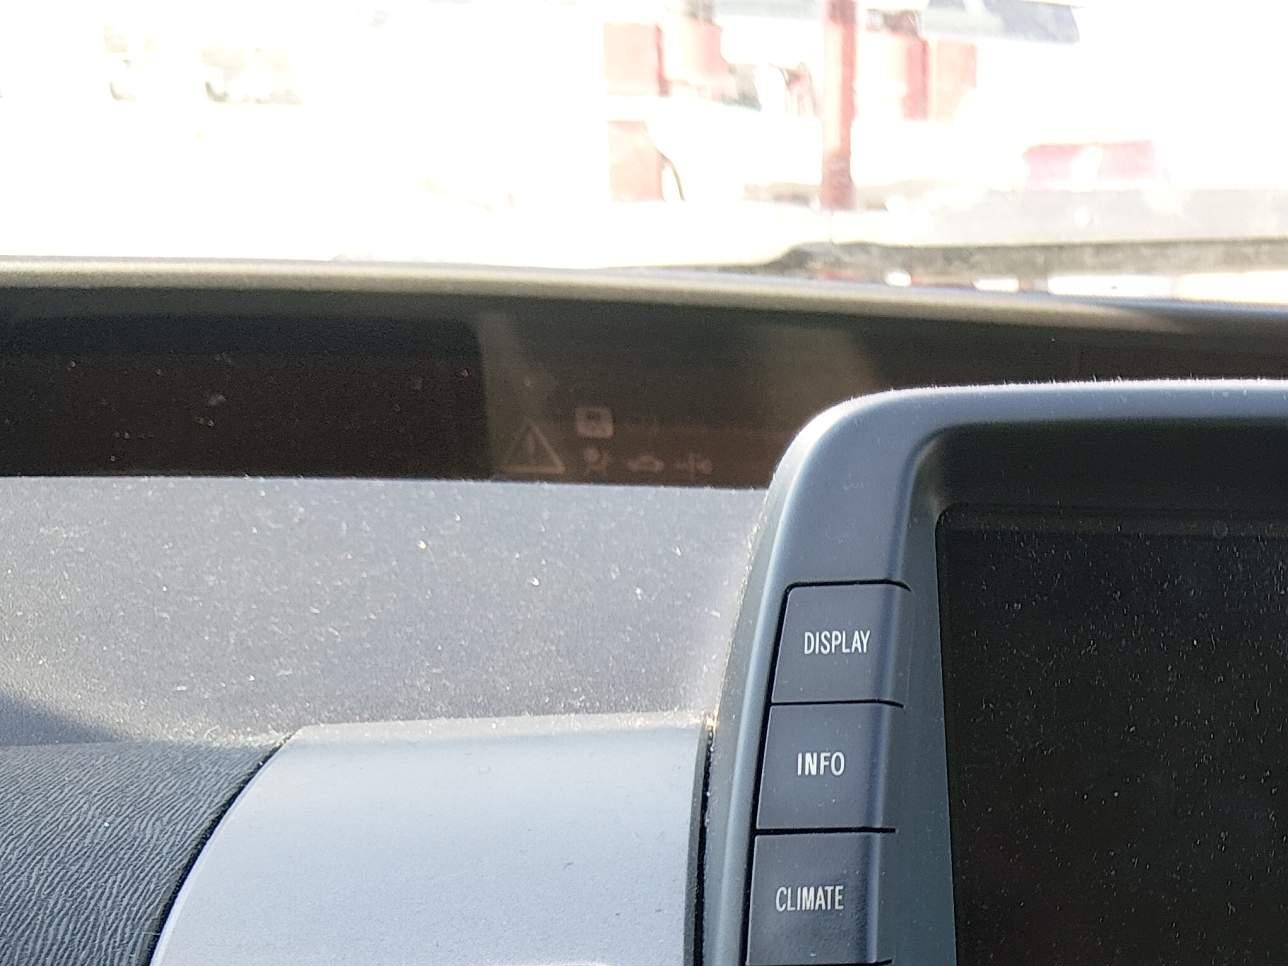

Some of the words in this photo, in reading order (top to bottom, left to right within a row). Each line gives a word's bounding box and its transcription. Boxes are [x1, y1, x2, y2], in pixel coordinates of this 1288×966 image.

[803, 629, 871, 655] DISPLAY
[797, 750, 845, 777] INFO
[775, 883, 845, 912] CLIMATE
